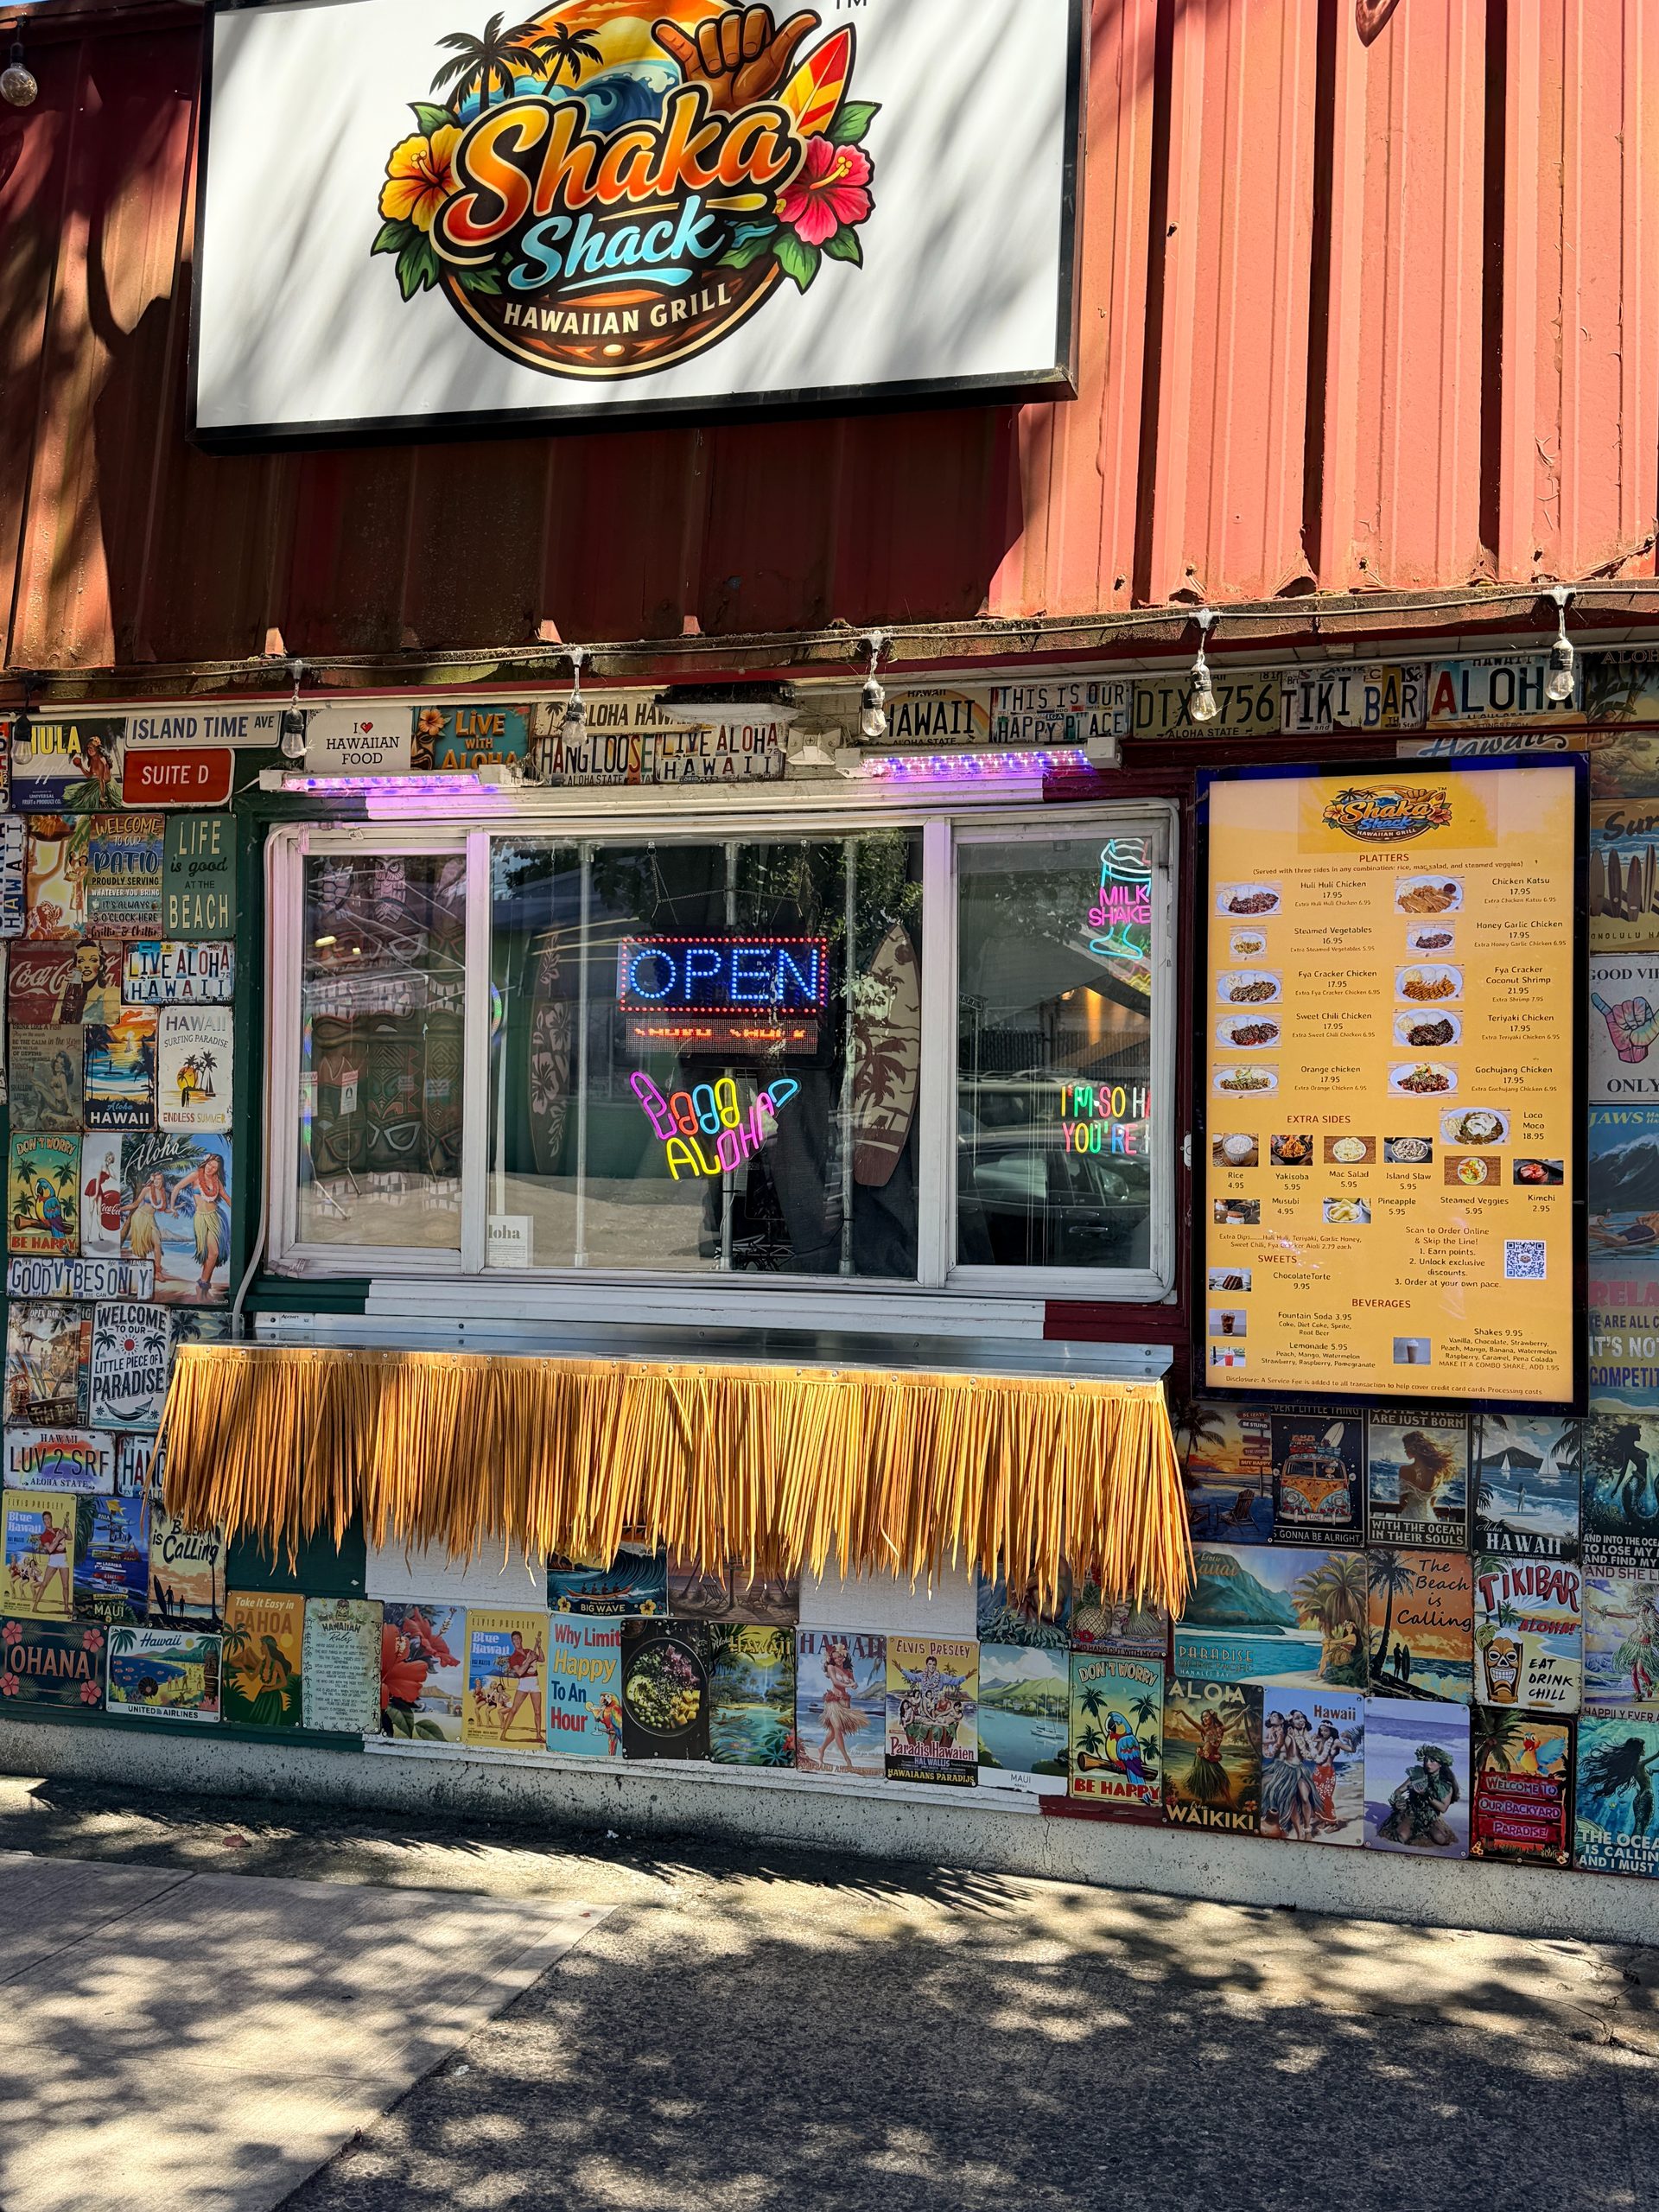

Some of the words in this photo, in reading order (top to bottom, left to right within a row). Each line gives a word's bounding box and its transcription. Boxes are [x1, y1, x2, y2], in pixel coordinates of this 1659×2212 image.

[439, 84, 793, 245] Shaka
[507, 195, 724, 289] Shack
[504, 303, 639, 336] HAWAIIAN
[651, 283, 732, 326] GRILL
[1000, 685, 1047, 710] THIS
[1057, 683, 1079, 709] IS
[1089, 684, 1124, 707] OUR
[1281, 676, 1351, 728] TIKI
[1363, 674, 1418, 726] BAR
[132, 717, 198, 740] ISLAND
[204, 715, 249, 738] TIME
[254, 715, 274, 728] AVE
[998, 714, 1057, 743] HAPPY
[1168, 728, 1204, 739] ALOHA
[1207, 727, 1239, 736] STATE
[327, 736, 400, 750] HAWAIIAN
[662, 731, 711, 757] LIVE
[716, 722, 778, 753] ALOHA
[342, 752, 383, 765] FOOD
[591, 734, 653, 774] LOOSE
[142, 766, 191, 785] SUITE
[198, 765, 210, 785] D
[664, 755, 772, 780] HAWAII
[568, 775, 595, 786] ALOHA
[596, 774, 625, 785] STATE
[1339, 799, 1433, 823] Shaka
[96, 817, 162, 836] WELCOME
[179, 821, 221, 855] LIFE
[94, 851, 159, 874] PATIO
[1359, 854, 1409, 862] PLATTERS
[92, 877, 124, 886] PROUDLY
[128, 876, 159, 886] SERVING
[1099, 885, 1150, 906] MILK
[169, 893, 229, 930] BEACH
[1088, 905, 1151, 927] SHAKE
[1330, 926, 1372, 936] Vegetables
[129, 951, 171, 979] LIVE
[176, 945, 231, 978] ALOHA
[630, 948, 817, 1000] OPEN
[1522, 976, 1551, 985] Shrimp
[131, 979, 225, 1001] HAWAII
[166, 1015, 226, 1032] HAWAII
[1487, 1014, 1519, 1023] Teriyaki
[164, 1034, 193, 1048] SURFING
[194, 1034, 229, 1048] PARADISE
[1475, 1065, 1518, 1075] Gochujang
[90, 1111, 149, 1124] HAWAII
[163, 1112, 194, 1123] ENDLESS
[197, 1113, 226, 1123] SUMMER
[1287, 1115, 1319, 1123] EXTRA
[1322, 1115, 1351, 1123] SIDES
[11, 1236, 28, 1249] BE
[31, 1236, 76, 1250] HAPPY
[1257, 1255, 1298, 1263] SWEETS
[1351, 1299, 1411, 1308] BEVERAGES
[97, 1306, 168, 1332] WELCOME
[95, 1357, 124, 1374] LITTLE
[126, 1354, 149, 1370] PIECE
[149, 1353, 159, 1365] OF
[92, 1367, 165, 1402] PARADISE
[1372, 1414, 1395, 1424] ARE
[1397, 1414, 1426, 1426] JUST
[1431, 1416, 1465, 1427] BORN
[41, 1433, 78, 1444] HAWAII
[10, 1446, 47, 1473] LUV
[54, 1448, 63, 1475] 2
[72, 1449, 110, 1477] SRF
[30, 1478, 58, 1487] ALOHA
[60, 1479, 88, 1489] STATE
[1372, 1520, 1400, 1532] WITH
[1403, 1522, 1424, 1533] THE
[1427, 1523, 1464, 1535] OCEAN
[1372, 1530, 1384, 1541] IN
[1386, 1531, 1422, 1542] THEIR
[1425, 1534, 1465, 1546] SOULS
[1486, 1532, 1562, 1555] HAWAII
[1602, 1544, 1632, 1555] LOSE
[1419, 1559, 1452, 1573] The
[1414, 1575, 1471, 1592] Beach
[94, 1603, 124, 1618] MAUI
[581, 1603, 594, 1613] BIG
[596, 1603, 626, 1613] WAVE
[321, 1622, 361, 1633] HAWAIIAN
[1396, 1609, 1471, 1632] Calling
[1518, 1618, 1577, 1636] ALOHA!
[140, 1632, 182, 1648] Hawaii
[472, 1631, 499, 1643] Blue
[554, 1623, 581, 1649] Why
[583, 1626, 621, 1648] Limit
[471, 1642, 510, 1656] Hawaii
[896, 1640, 925, 1655] ELVIS
[931, 1643, 971, 1659] PRESLEY
[1179, 1645, 1254, 1662] PARADISE
[10, 1645, 91, 1680] OHANA
[553, 1647, 618, 1683] Happy
[1529, 1658, 1557, 1670] EAT
[1078, 1662, 1116, 1683] DON'T
[1117, 1662, 1159, 1687] WORRY
[1529, 1674, 1573, 1687] DRINK
[551, 1680, 566, 1700] To
[568, 1683, 587, 1704] An
[1529, 1688, 1566, 1700] CHILL
[128, 1706, 156, 1715] UNITED
[163, 1707, 199, 1719] AIRLINES
[550, 1707, 588, 1732] Hour
[1313, 1704, 1357, 1721] Hawaii
[937, 1773, 976, 1784] PARADIJS
[1010, 1774, 1031, 1783] MAUI
[1074, 1778, 1097, 1793] BE
[1101, 1780, 1160, 1800] HAPPY
[1167, 1805, 1254, 1830] WAIKIKI
[1618, 1857, 1655, 1873] MUST
